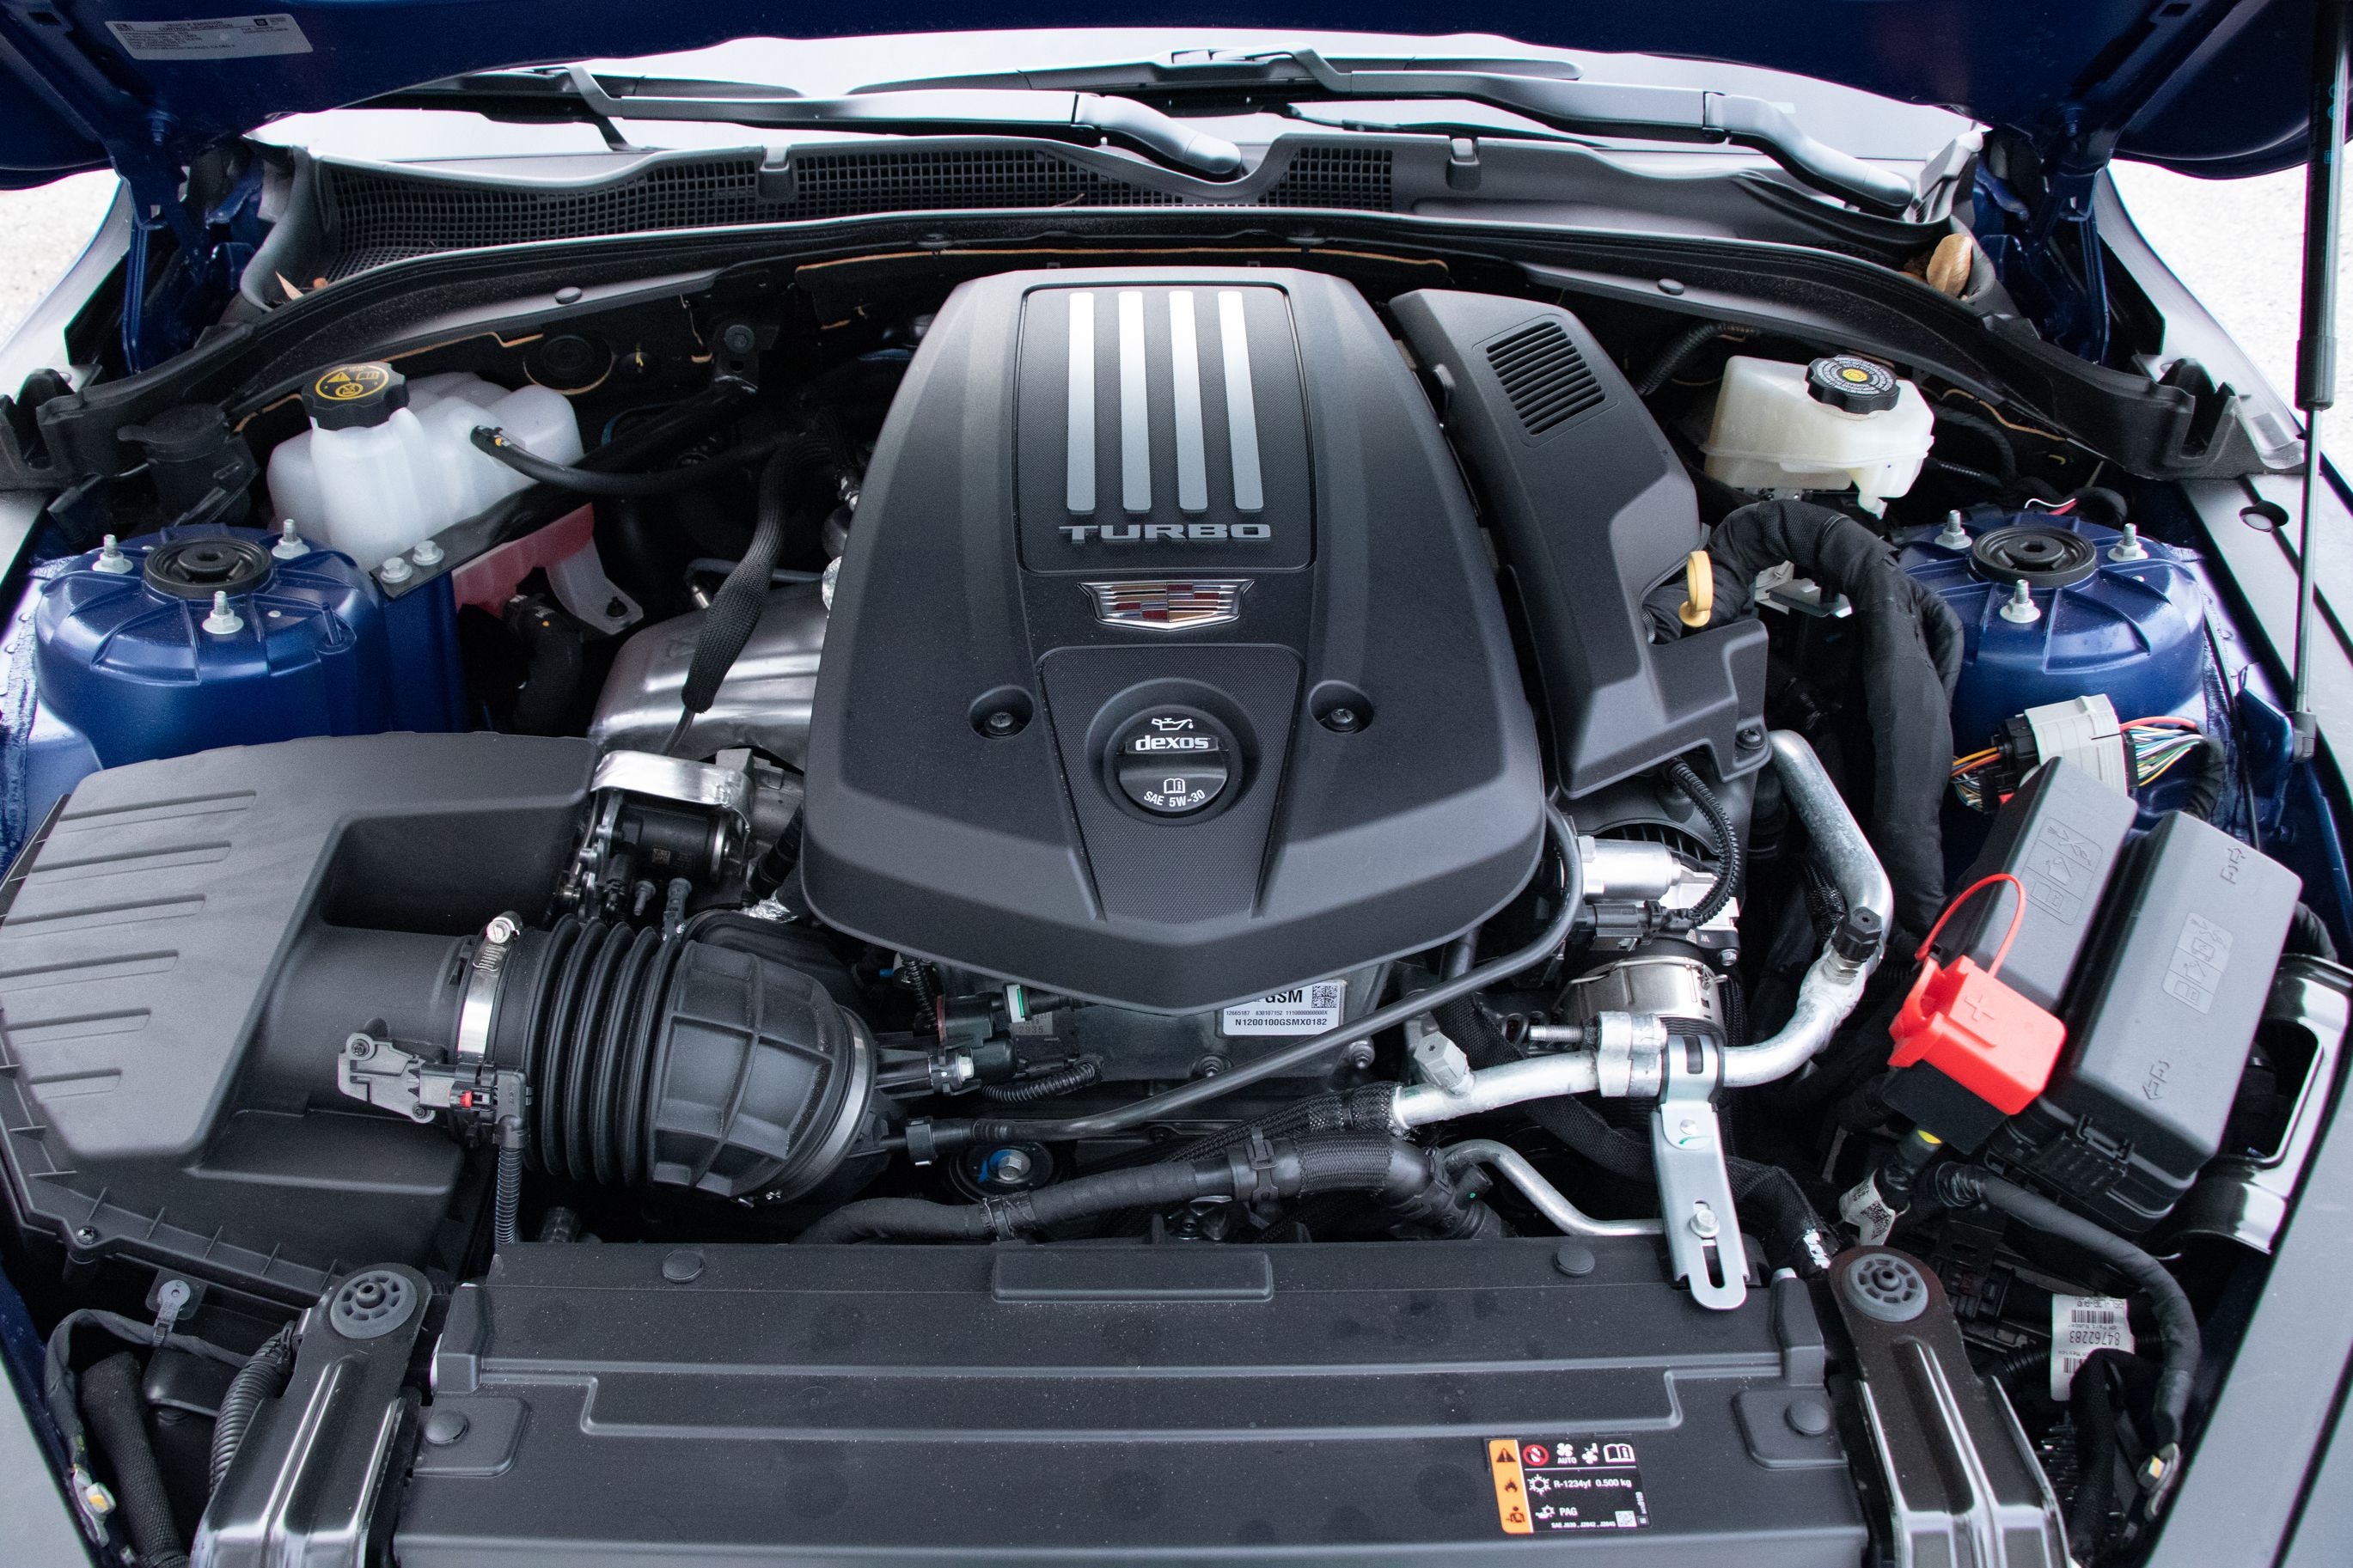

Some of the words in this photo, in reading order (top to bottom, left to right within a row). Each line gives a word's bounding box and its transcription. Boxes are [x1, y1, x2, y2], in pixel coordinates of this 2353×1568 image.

[1059, 523, 1271, 544] TURBO
[1135, 735, 1209, 751] dexos
[1144, 790, 1164, 806] SAE
[1169, 789, 1206, 807] 5W-30
[1235, 1018, 1328, 1027] N1200100GSMX0182
[2069, 1330, 2120, 1346] 84762283
[1595, 1479, 1619, 1487] 0.500
[1620, 1478, 1632, 1488] kg
[1559, 1507, 1578, 1516] PAG
